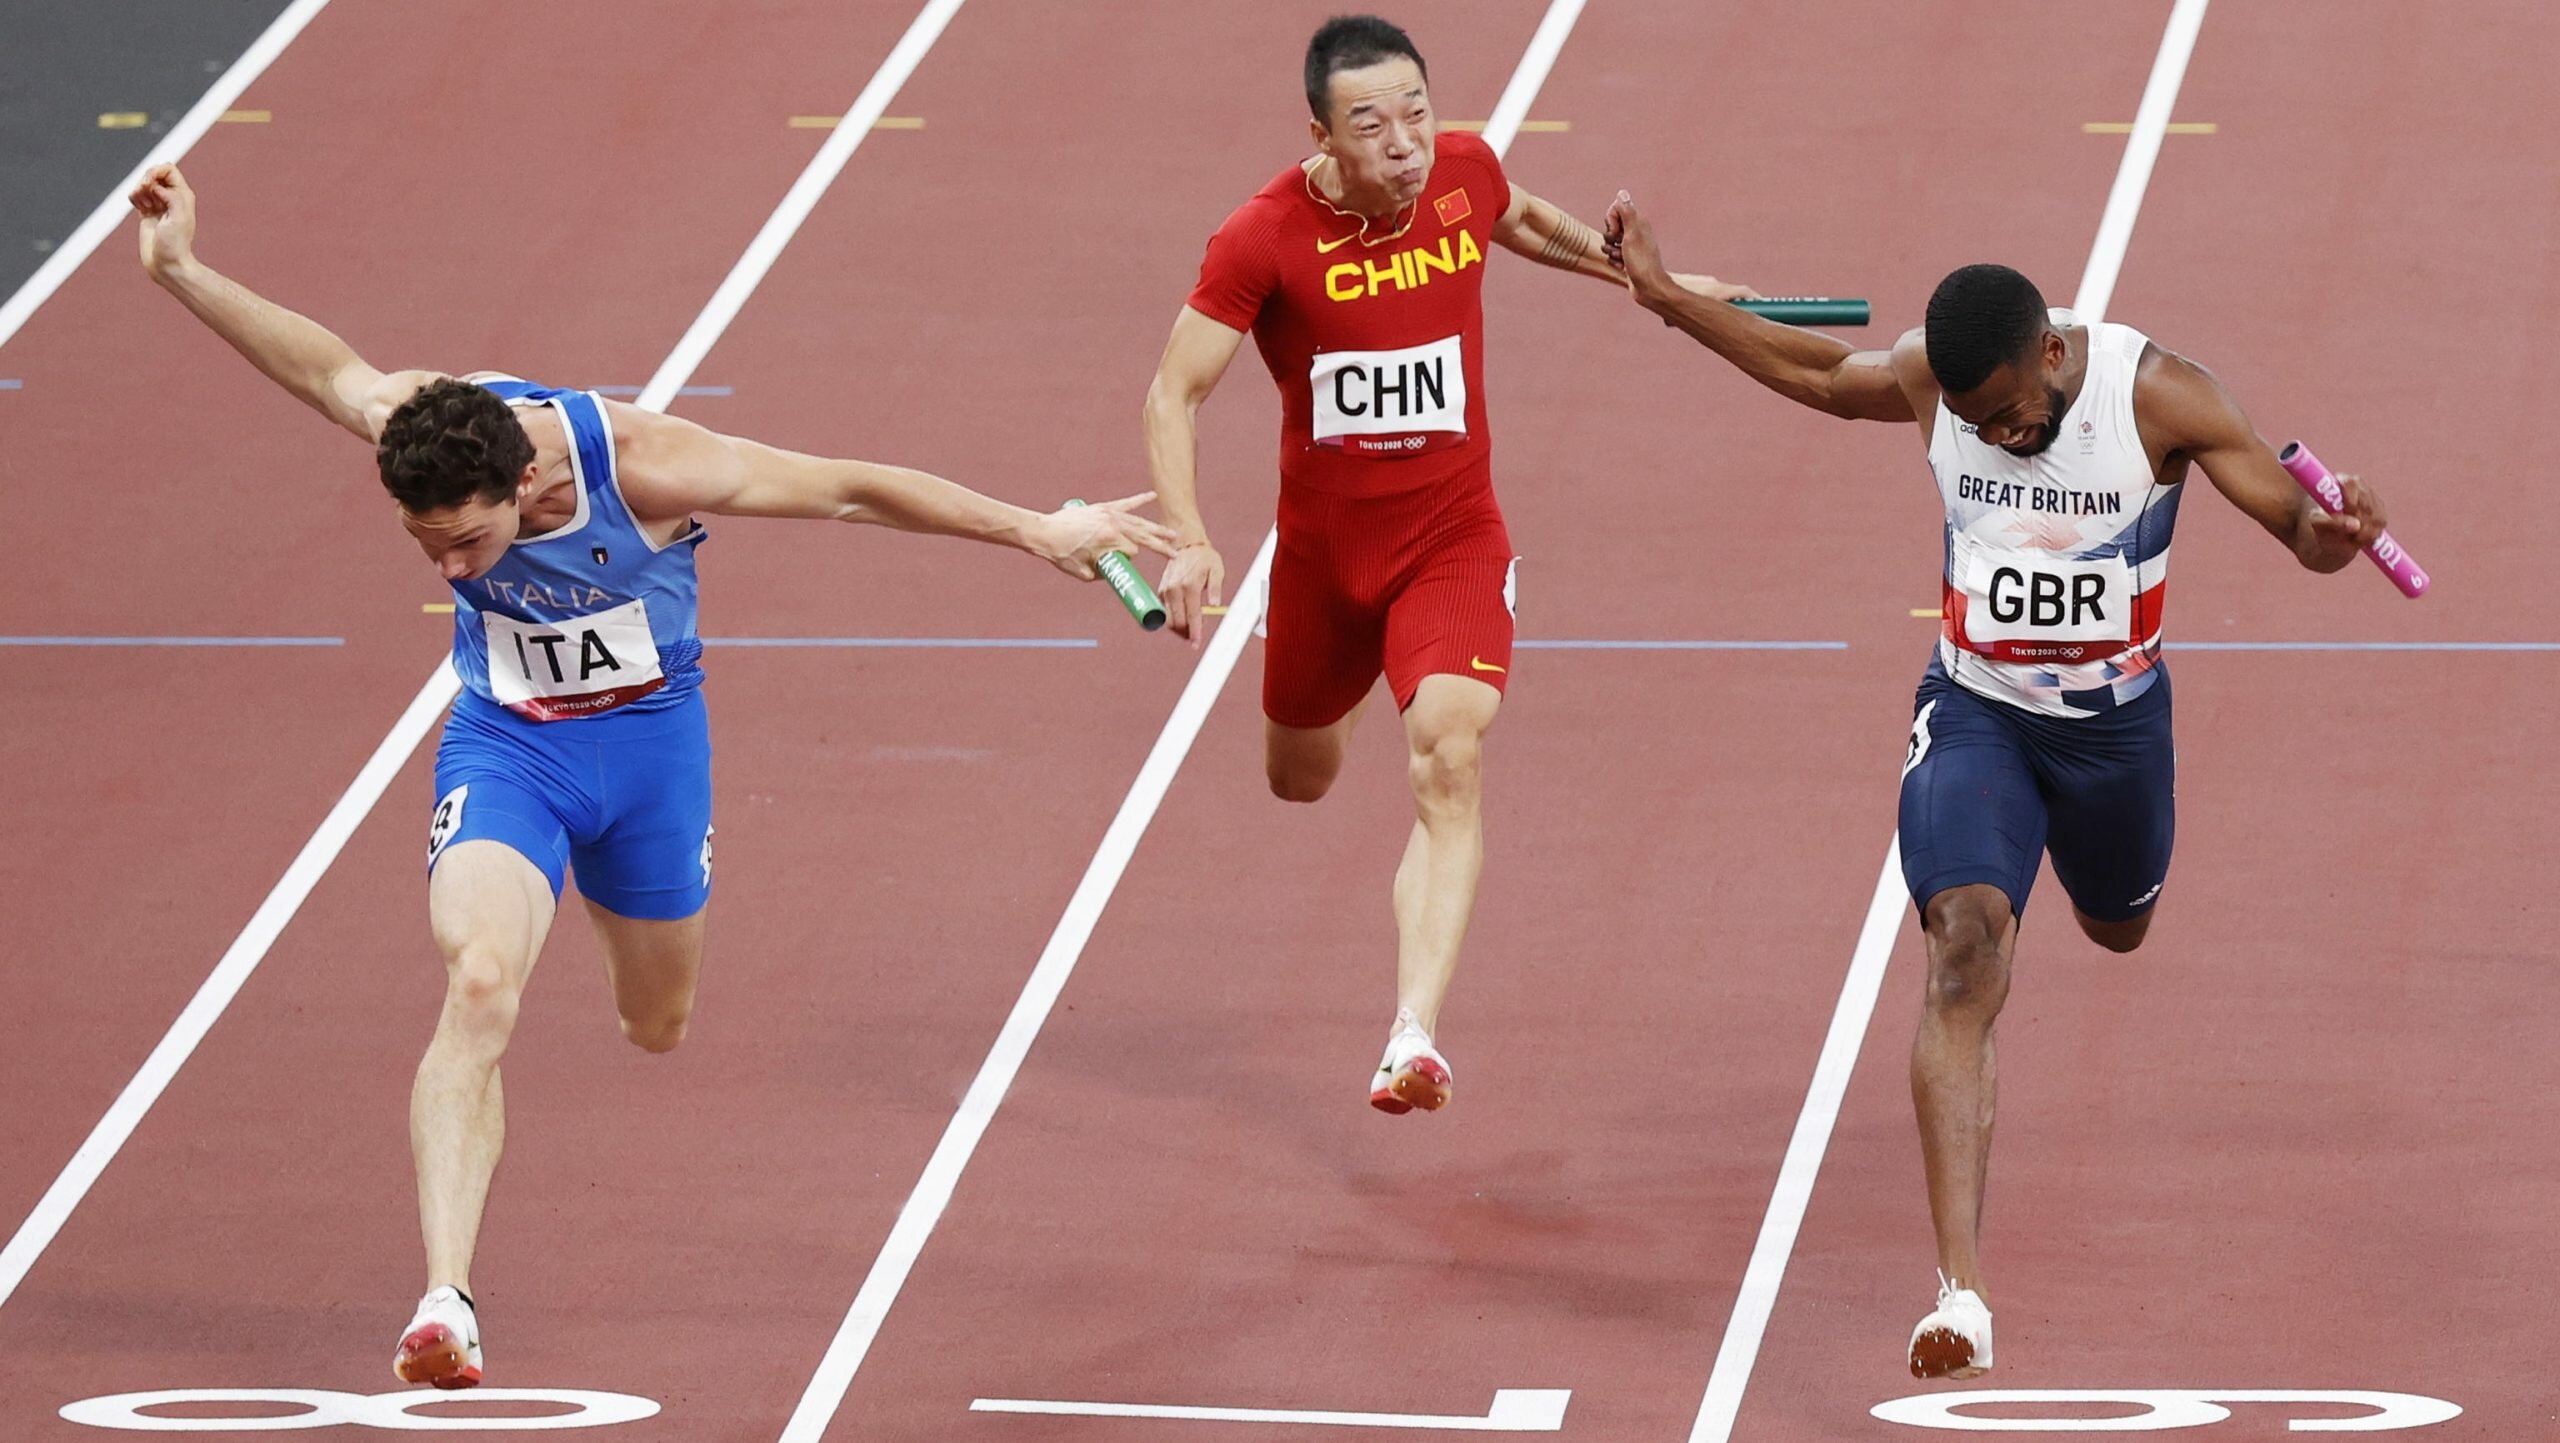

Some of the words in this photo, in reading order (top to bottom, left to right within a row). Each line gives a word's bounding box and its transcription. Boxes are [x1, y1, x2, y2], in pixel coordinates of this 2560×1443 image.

[1325, 229, 1482, 301] CHINA
[1334, 356, 1446, 418] CHN
[1359, 440, 1383, 450] TOKYO
[1384, 440, 1402, 450] 2020
[1958, 474, 2025, 509] GREAT
[2032, 486, 2122, 515] BRITAIN
[2316, 475, 2344, 511] 020
[2372, 533, 2402, 571] TOK
[484, 577, 613, 609] ITALIA
[1988, 566, 2107, 627] GBR
[513, 628, 622, 684] ITA
[2010, 646, 2037, 656] TOKYO
[2037, 648, 2057, 656] 2020
[58, 1388, 662, 1431] 8
